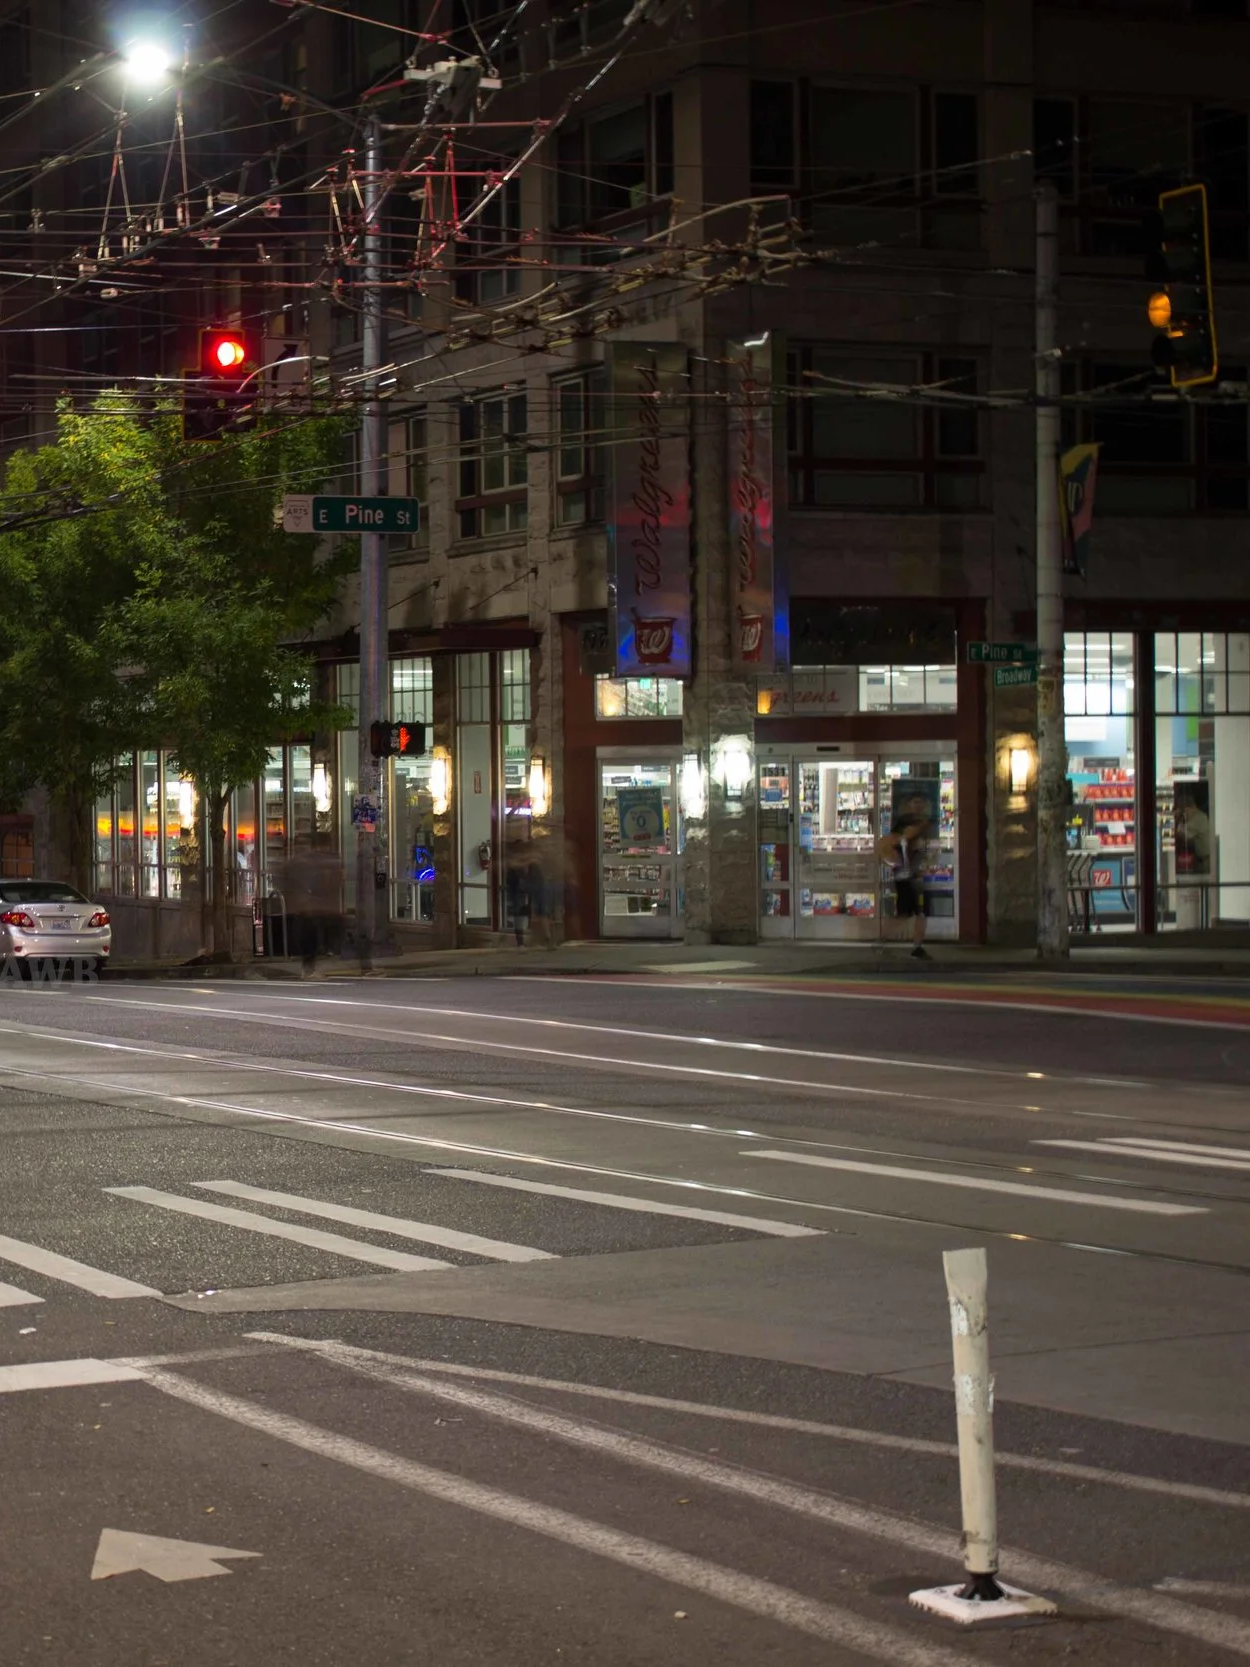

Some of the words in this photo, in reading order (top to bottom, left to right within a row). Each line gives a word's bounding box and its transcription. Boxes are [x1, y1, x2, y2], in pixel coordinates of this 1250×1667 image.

[632, 355, 674, 597] Walgreens
[286, 508, 308, 516] ARTS
[319, 509, 328, 523] E
[345, 504, 384, 524] Pine
[397, 510, 410, 525] St
[971, 648, 977, 659] E
[981, 643, 1008, 660] Pine
[997, 668, 1032, 685] Broadway
